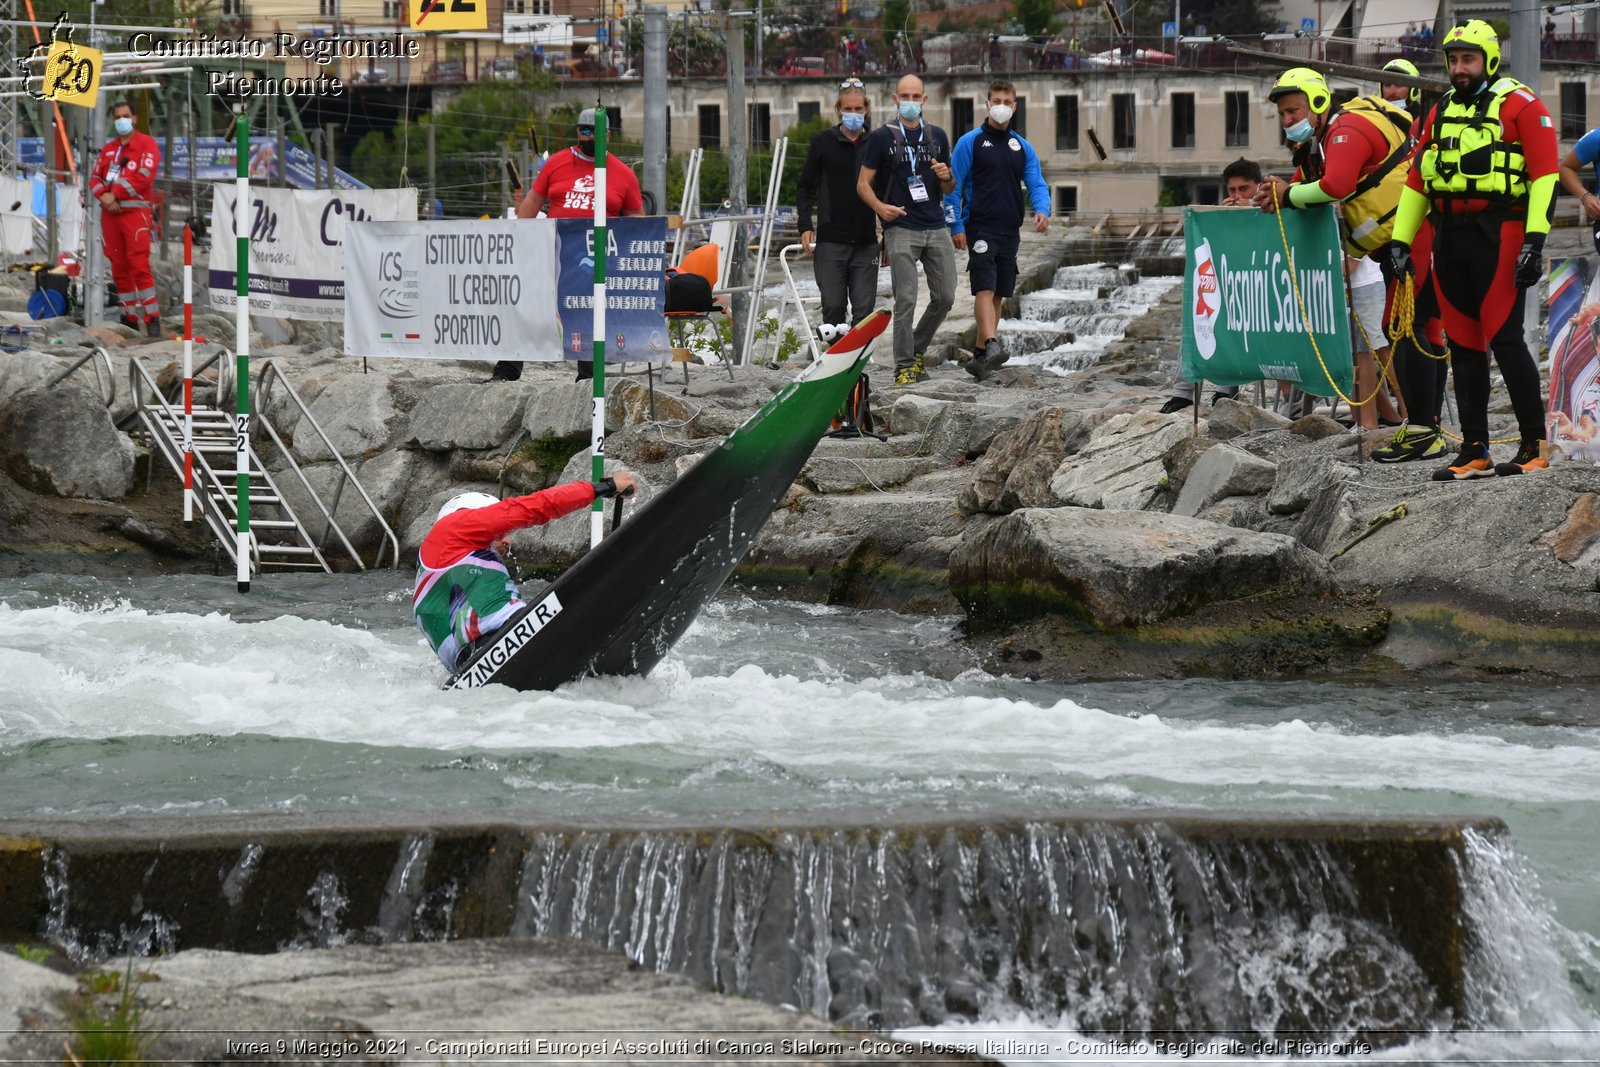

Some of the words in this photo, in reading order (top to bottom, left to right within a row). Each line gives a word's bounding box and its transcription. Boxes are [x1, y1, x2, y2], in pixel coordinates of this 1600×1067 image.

[57, 54, 93, 93] 20
[565, 191, 594, 200] IVRE
[425, 234, 483, 264] ISTITUTO
[488, 234, 514, 264] PER
[586, 229, 618, 257] EA
[630, 240, 665, 254] CANOE
[379, 251, 402, 281] ICS
[618, 257, 662, 271] SLALOM
[449, 274, 459, 305] IL
[463, 275, 521, 306] CREDITO
[1272, 246, 1336, 335] Salumi
[434, 314, 501, 345] SPORTIVO
[535, 603, 557, 625] R.
